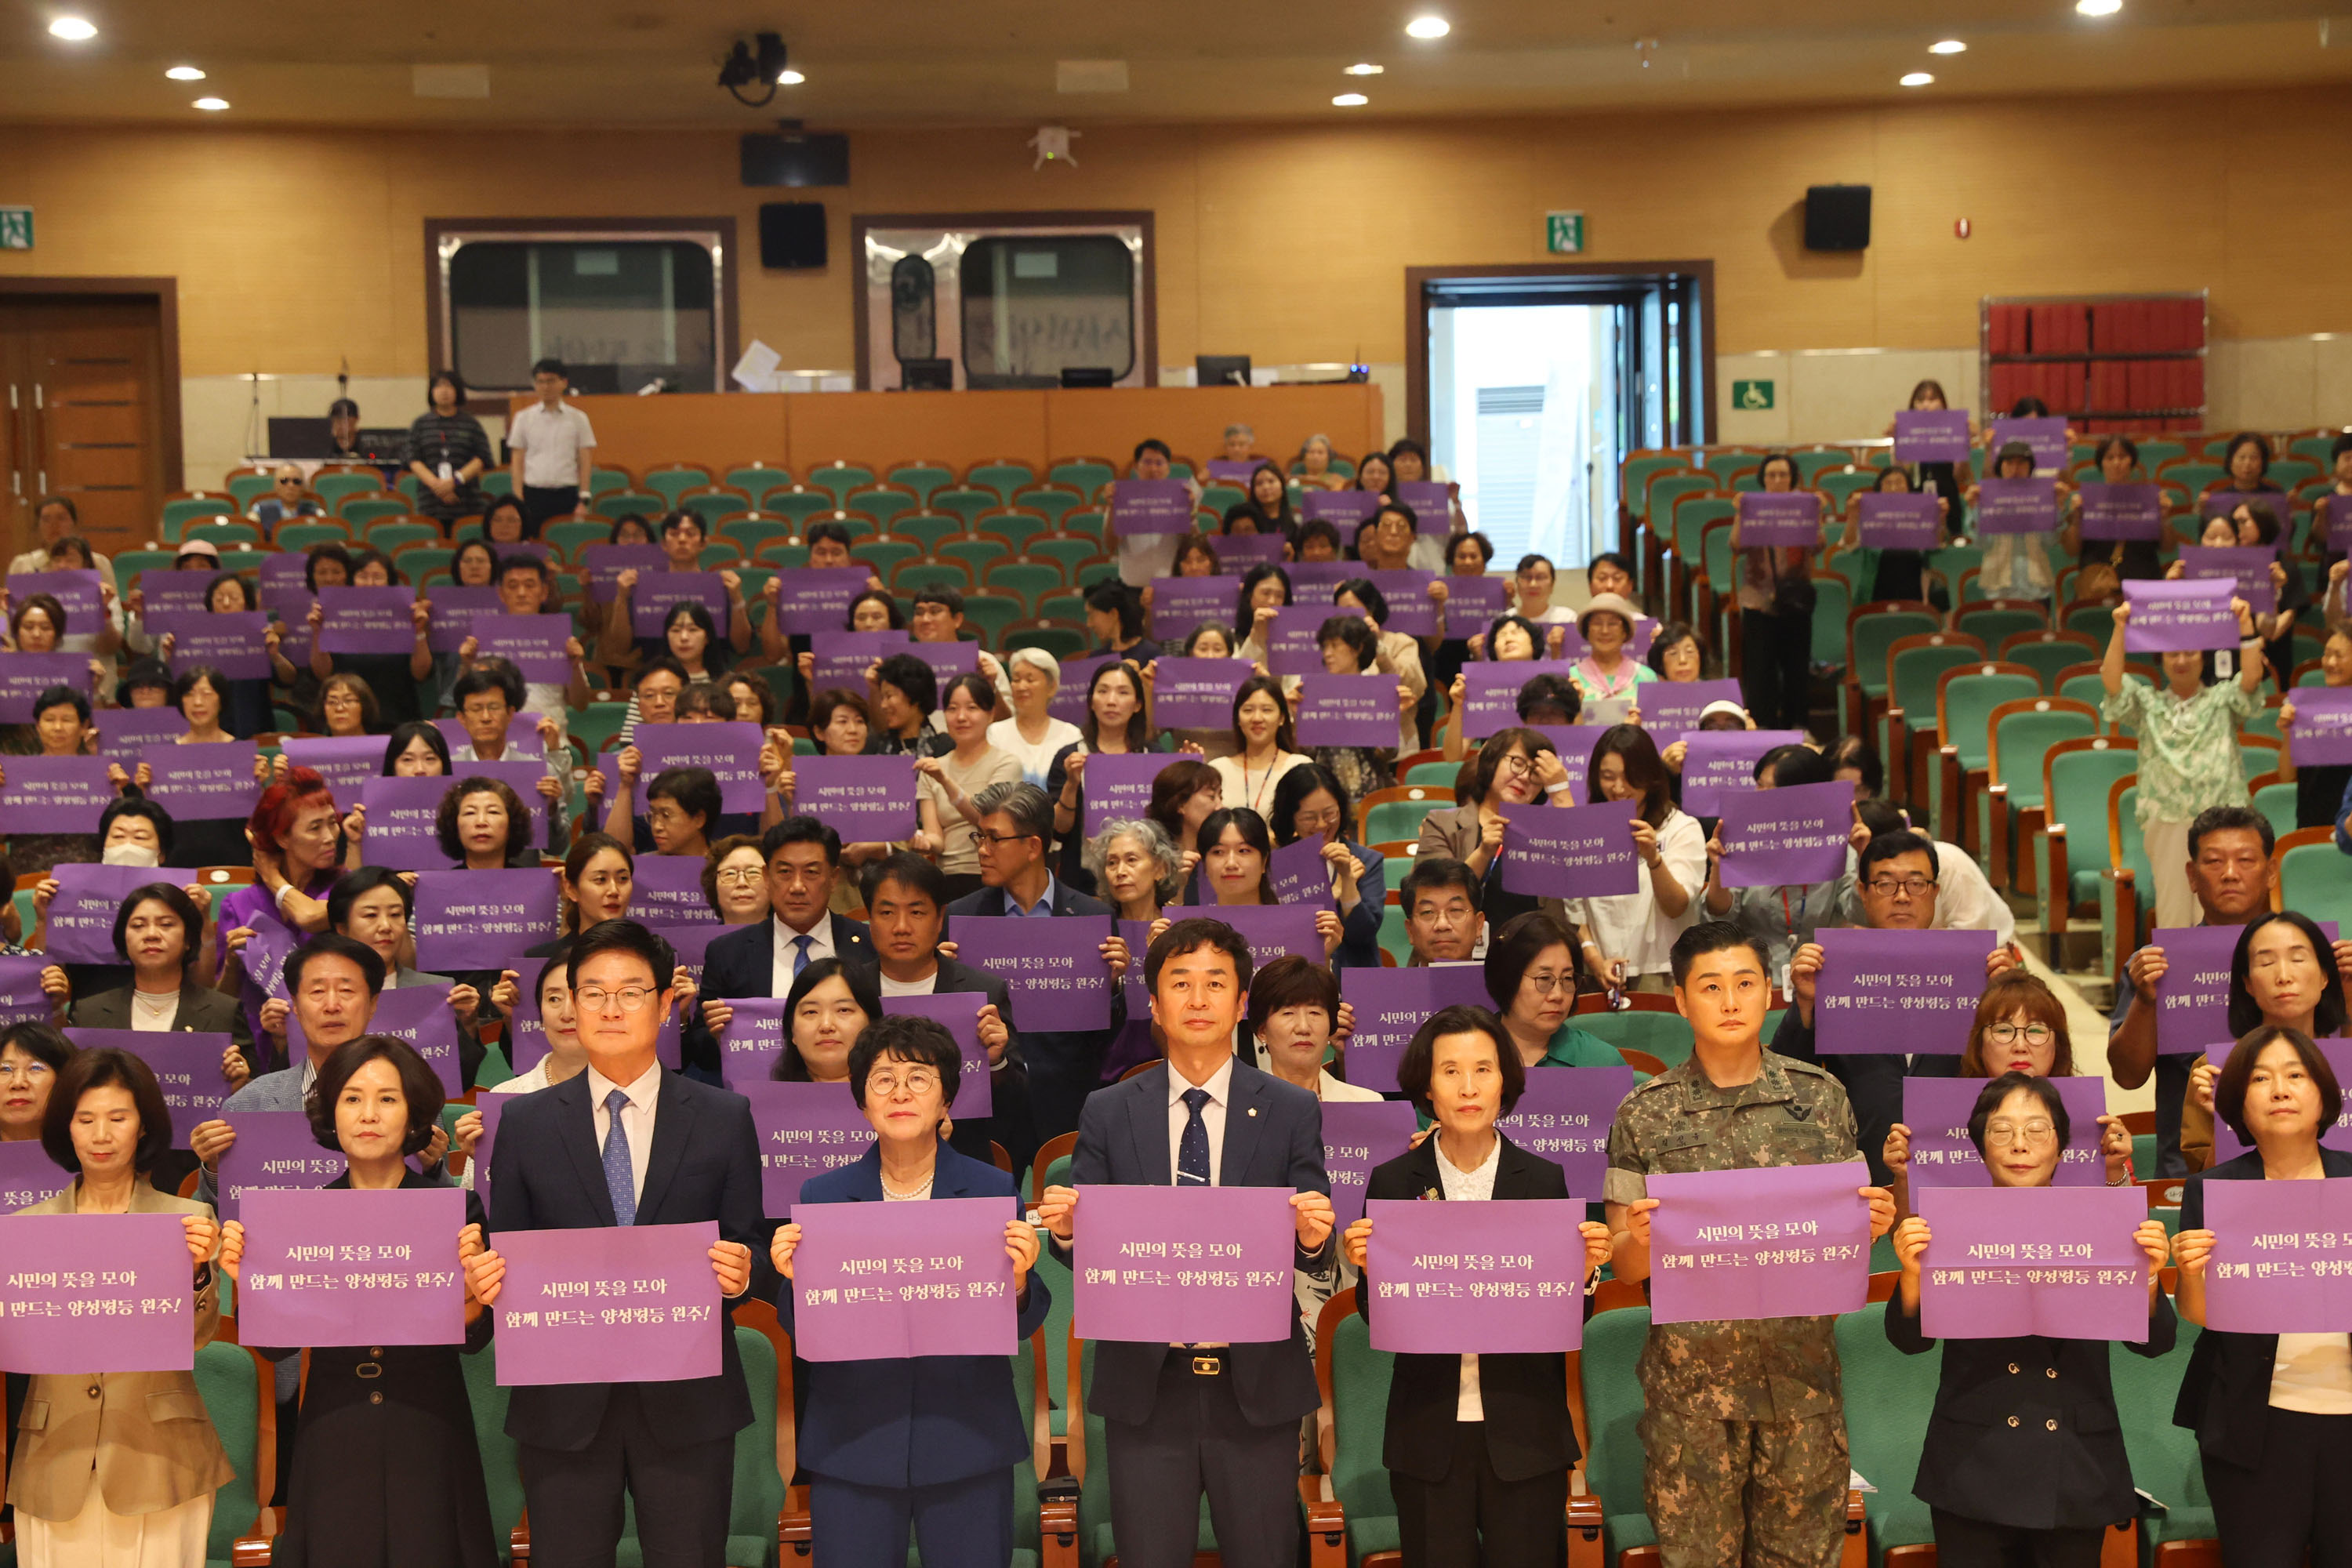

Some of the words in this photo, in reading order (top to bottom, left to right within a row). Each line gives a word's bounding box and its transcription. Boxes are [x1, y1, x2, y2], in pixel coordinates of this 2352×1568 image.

[982, 956, 1018, 969] 시민의
[1020, 956, 1044, 969] 뜻을
[1048, 956, 1074, 968] 모아
[1024, 976, 1072, 990] 양성평등
[1075, 976, 1105, 989] 원주!
[1852, 973, 1891, 986] 시민의
[1896, 974, 1921, 987] 뜻을
[1926, 974, 1954, 987] 모아
[1824, 994, 1851, 1009] 함께
[1855, 995, 1895, 1009] 만드는
[1899, 995, 1951, 1010] 양성평등
[2165, 993, 2191, 1009] 함께
[753, 1018, 782, 1030] 시민
[1378, 1011, 1417, 1024] 시민의
[728, 1038, 753, 1052] 함께
[1351, 1033, 1378, 1047] 함께
[1381, 1033, 1414, 1046] 만드
[420, 1044, 451, 1060] 원주!
[1526, 1113, 1555, 1128] 뜻을
[1559, 1113, 1590, 1127] 모아
[771, 1129, 813, 1144] 시민의
[816, 1129, 845, 1144] 뜻을
[1532, 1138, 1588, 1152] 양성평등
[774, 1153, 817, 1168] 만드는
[1338, 1146, 1370, 1161] 모아
[1914, 1149, 1944, 1165] 함께
[1948, 1149, 1984, 1164] 만드
[2061, 1148, 2097, 1163] 원주!
[261, 1159, 305, 1174] 시민의
[309, 1158, 339, 1174] 뜻을
[4, 1190, 34, 1206] 뜻을
[1695, 1224, 1744, 1242] 시민의
[1747, 1222, 1780, 1240] 뜻을
[1784, 1219, 1819, 1236] 모아
[2251, 1232, 2299, 1250] 시민의
[2303, 1231, 2337, 1249] 뜻을
[285, 1244, 334, 1261] 시민의
[338, 1244, 372, 1261] 뜻을
[376, 1243, 412, 1261] 모아
[1118, 1241, 1166, 1258] 시민의
[1171, 1242, 1203, 1258] 뜻을
[1208, 1243, 1243, 1259] 모아
[1661, 1253, 1693, 1269] 함께
[1700, 1252, 1749, 1268] 만드는
[1754, 1247, 1817, 1266] 양성평등
[1820, 1243, 1860, 1261] 원주!
[1966, 1243, 2015, 1259] 시민의
[2020, 1243, 2053, 1260] 뜻을
[2058, 1243, 2093, 1259] 모아
[839, 1258, 887, 1276] 시민의
[891, 1257, 924, 1274] 뜻을
[928, 1254, 964, 1271] 모아
[1411, 1254, 1458, 1270] 시민의
[1463, 1254, 1495, 1270] 뜻을
[1499, 1254, 1534, 1270] 모아
[2216, 1261, 2250, 1279] 함께
[2255, 1261, 2306, 1278] 만드는
[6, 1271, 56, 1289] 시민의
[61, 1271, 96, 1288] 뜻을
[100, 1269, 137, 1287] 모아
[249, 1272, 283, 1290] 함께
[289, 1272, 339, 1290] 만드는
[343, 1272, 409, 1290] 양성평등
[413, 1271, 455, 1287] 원주!
[1084, 1267, 1116, 1285] 함께
[1122, 1269, 1171, 1286] 만드는
[1176, 1269, 1240, 1287] 양성평등
[1244, 1270, 1284, 1287] 원주!
[1931, 1269, 1965, 1286] 함께
[1970, 1269, 2020, 1285] 만드는
[2025, 1269, 2090, 1285] 양성평등
[2095, 1269, 2137, 1285] 원주!
[539, 1280, 589, 1298] 시민의
[593, 1279, 627, 1297] 뜻을
[632, 1277, 668, 1294] 모아
[804, 1287, 838, 1306] 함께
[843, 1286, 893, 1303] 만드는
[898, 1283, 961, 1301] 양성평등
[966, 1280, 1005, 1298] 원주!
[1377, 1280, 1410, 1298] 함께
[1414, 1281, 1464, 1298] 만드는
[1468, 1280, 1531, 1298] 양성평등
[1535, 1280, 1575, 1298] 원주!
[9, 1300, 62, 1317] 만드는
[67, 1298, 134, 1317] 양성평등
[139, 1297, 182, 1314] 원주!
[505, 1310, 539, 1328] 함께
[544, 1309, 595, 1327] 만드는
[600, 1306, 666, 1325] 양성평등
[670, 1305, 710, 1322] 원주!
